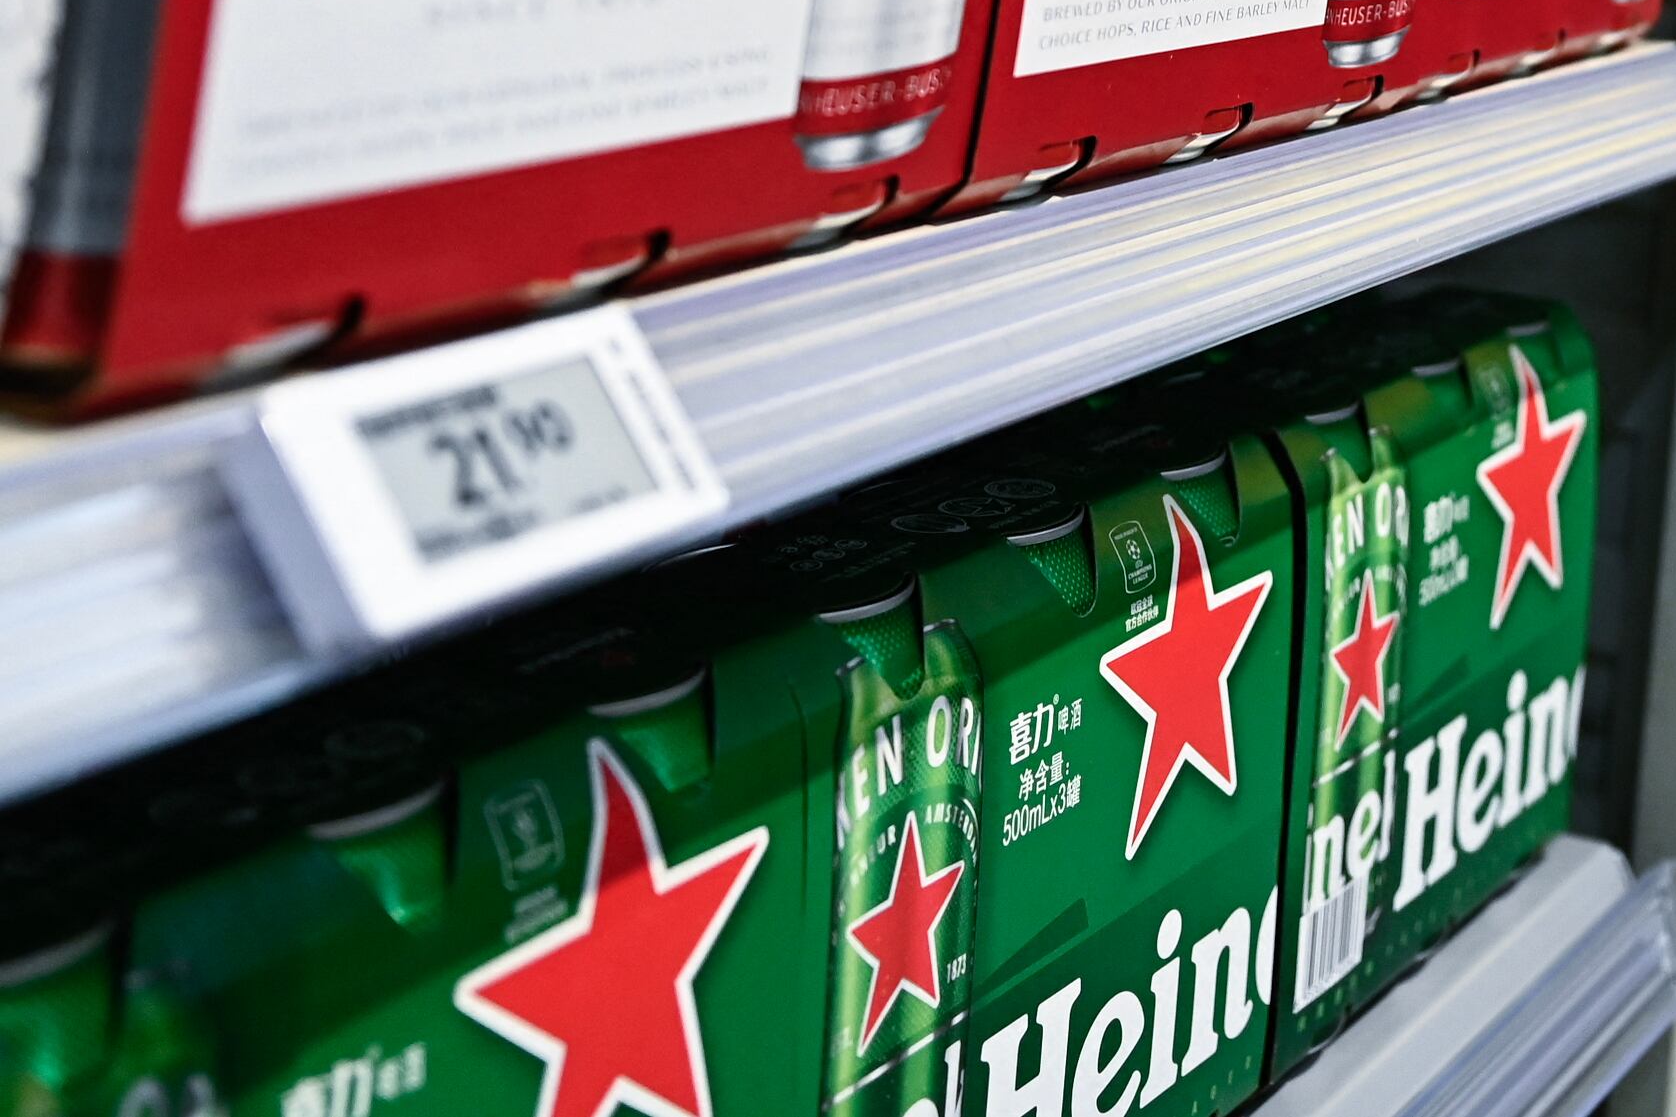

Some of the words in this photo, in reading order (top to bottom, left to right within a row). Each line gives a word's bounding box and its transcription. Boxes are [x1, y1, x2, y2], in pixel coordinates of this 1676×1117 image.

[1039, 27, 1093, 50] CHOICE
[1141, 15, 1173, 34] RICE
[1174, 11, 1202, 29] AND
[1205, 5, 1233, 25] FINE
[1236, 0, 1280, 20] BARLEY
[1043, 0, 1103, 22] BREWED
[926, 694, 983, 795] ORI
